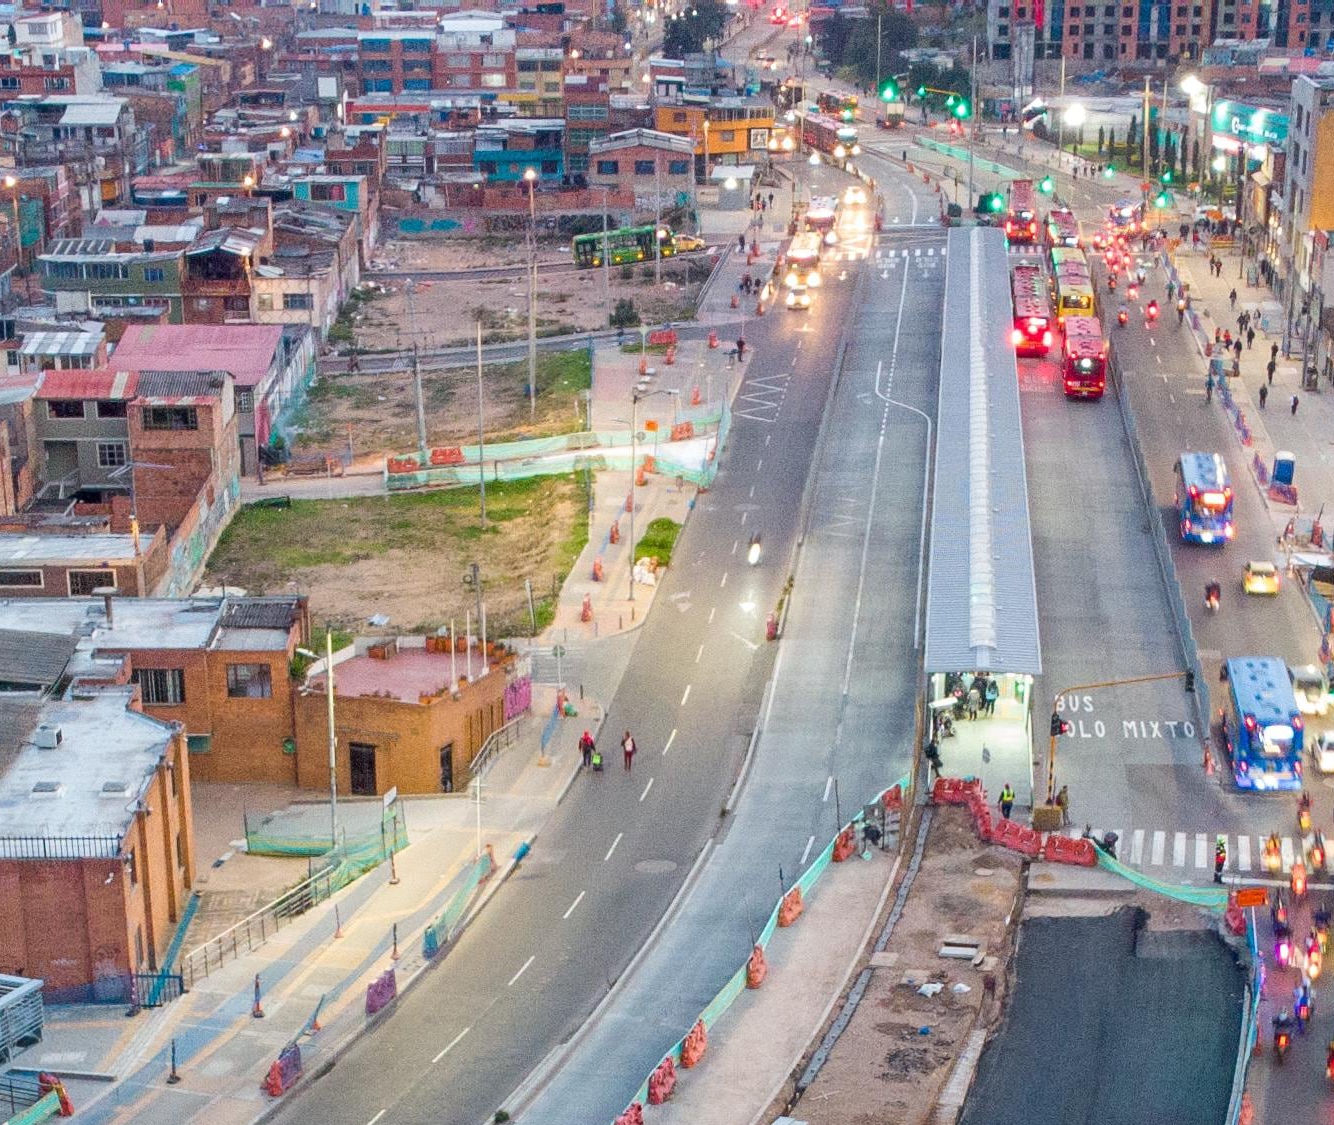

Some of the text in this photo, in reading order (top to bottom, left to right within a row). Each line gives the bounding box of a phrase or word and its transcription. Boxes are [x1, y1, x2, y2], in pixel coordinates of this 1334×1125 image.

[1055, 695, 1094, 713] BUS
[1062, 720, 1195, 739] OLO MIXTO
